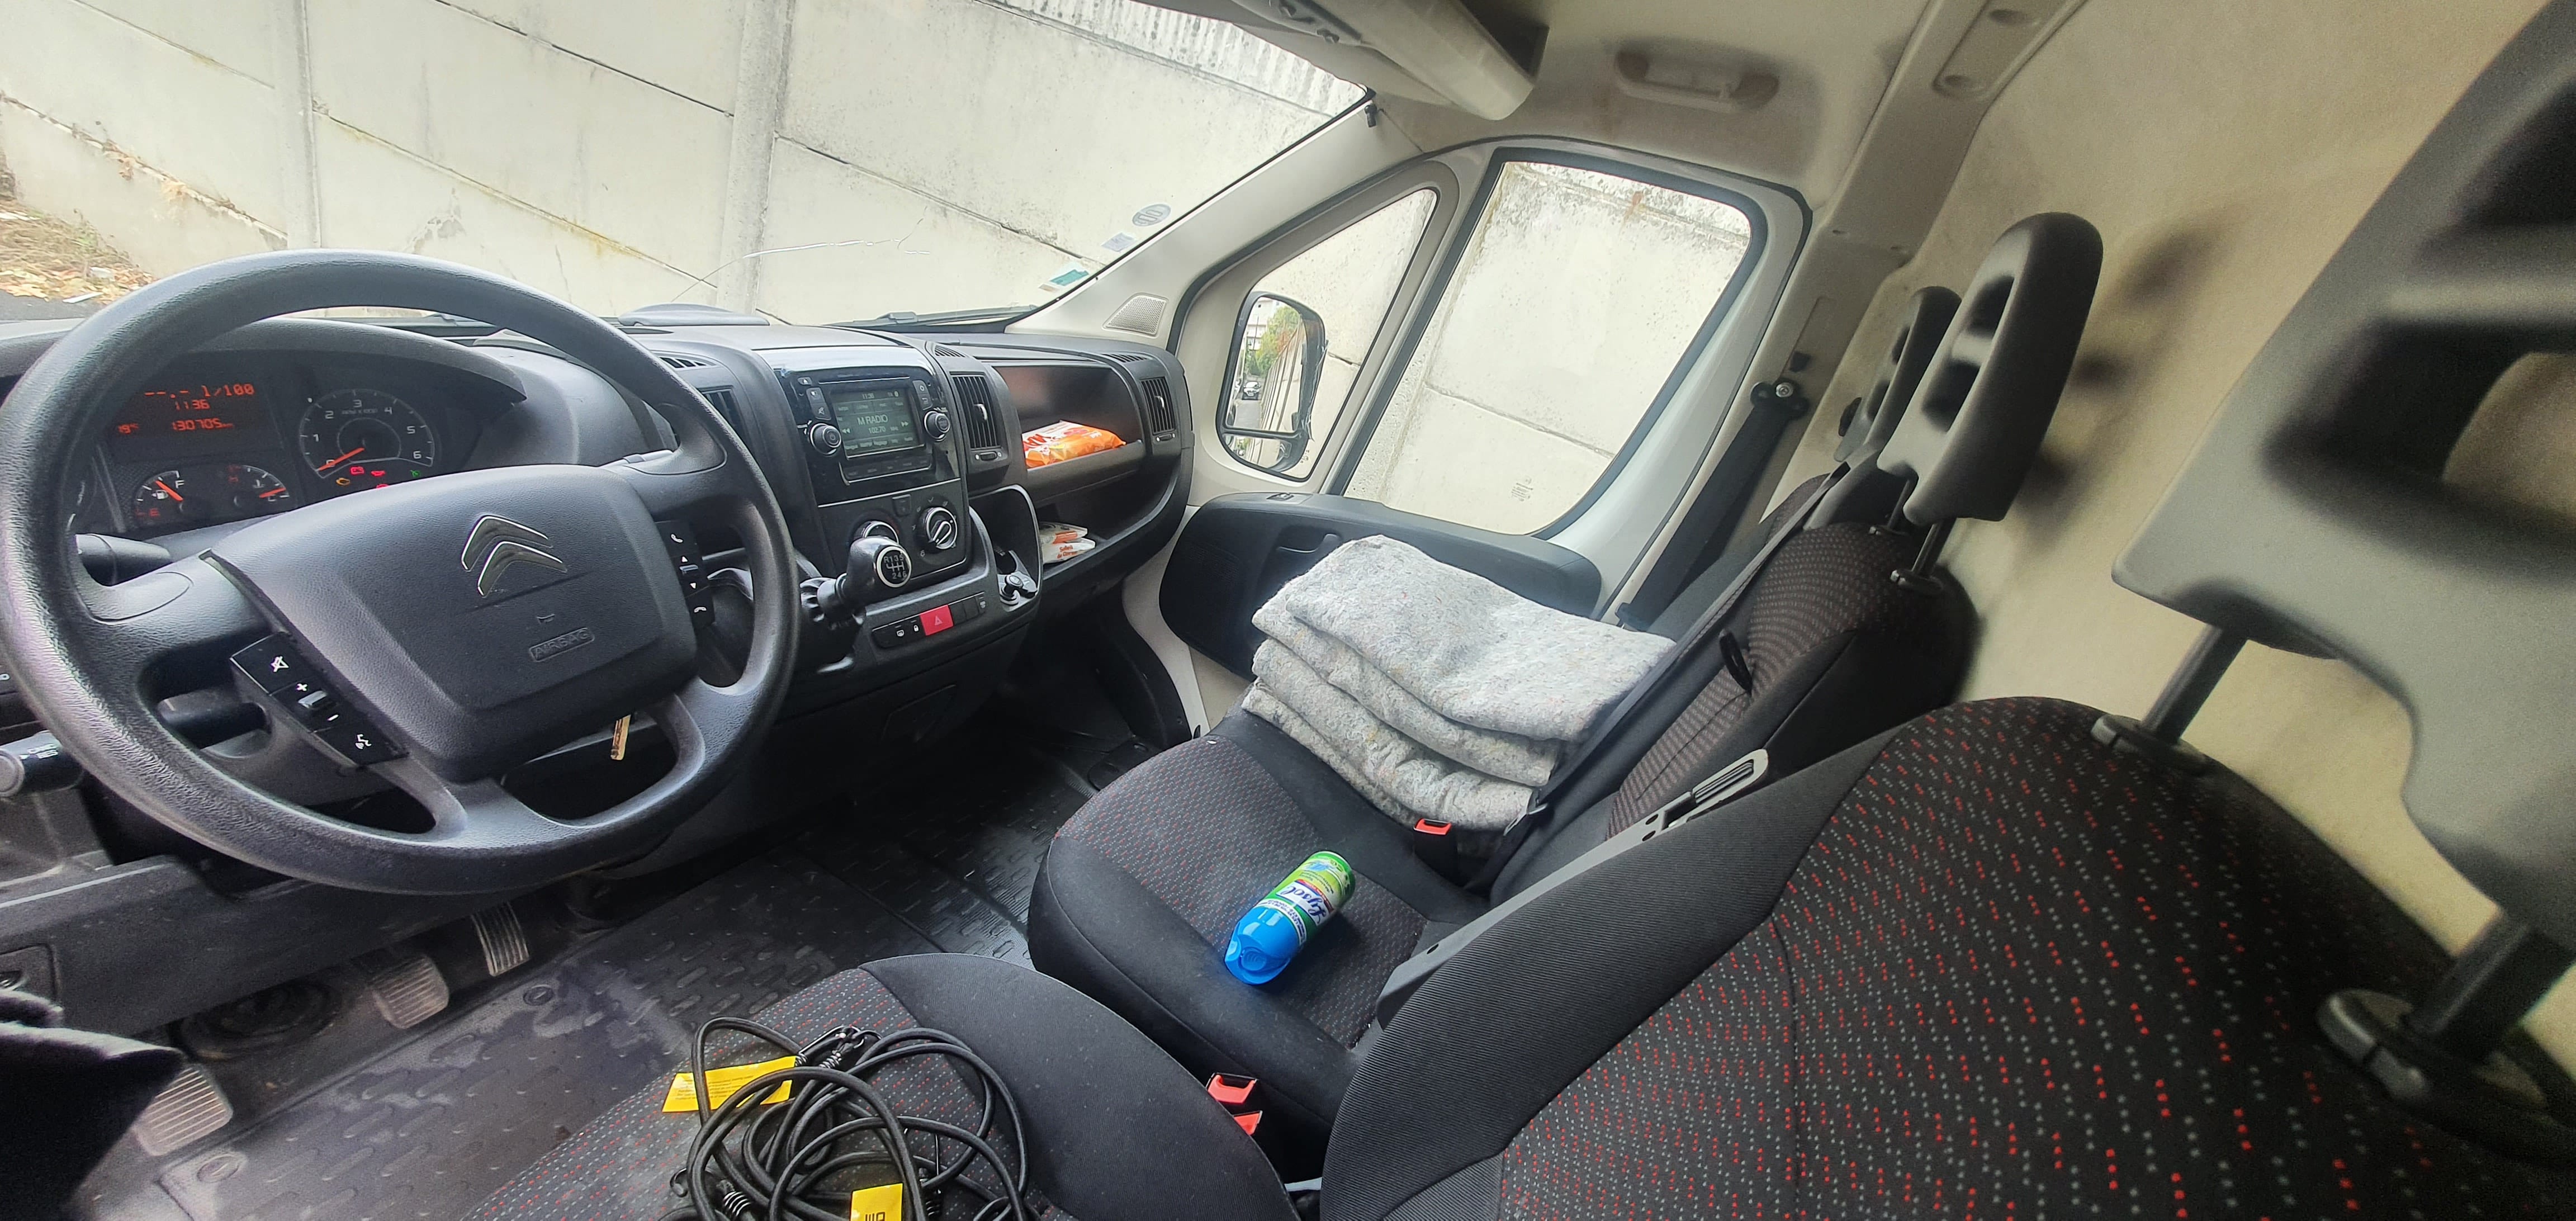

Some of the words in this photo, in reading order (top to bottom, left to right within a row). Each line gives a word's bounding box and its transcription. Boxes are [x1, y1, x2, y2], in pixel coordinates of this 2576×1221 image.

[353, 399, 362, 408] 3
[325, 411, 334, 419] 2
[384, 406, 392, 415] 4
[856, 417, 865, 425] M
[865, 414, 888, 425] RADIO
[406, 425, 416, 434] 5
[413, 451, 422, 459] 6
[175, 480, 185, 489] F
[149, 508, 160, 517] E
[535, 630, 590, 660] AIRBAG
[1280, 886, 1327, 924] Lysol
